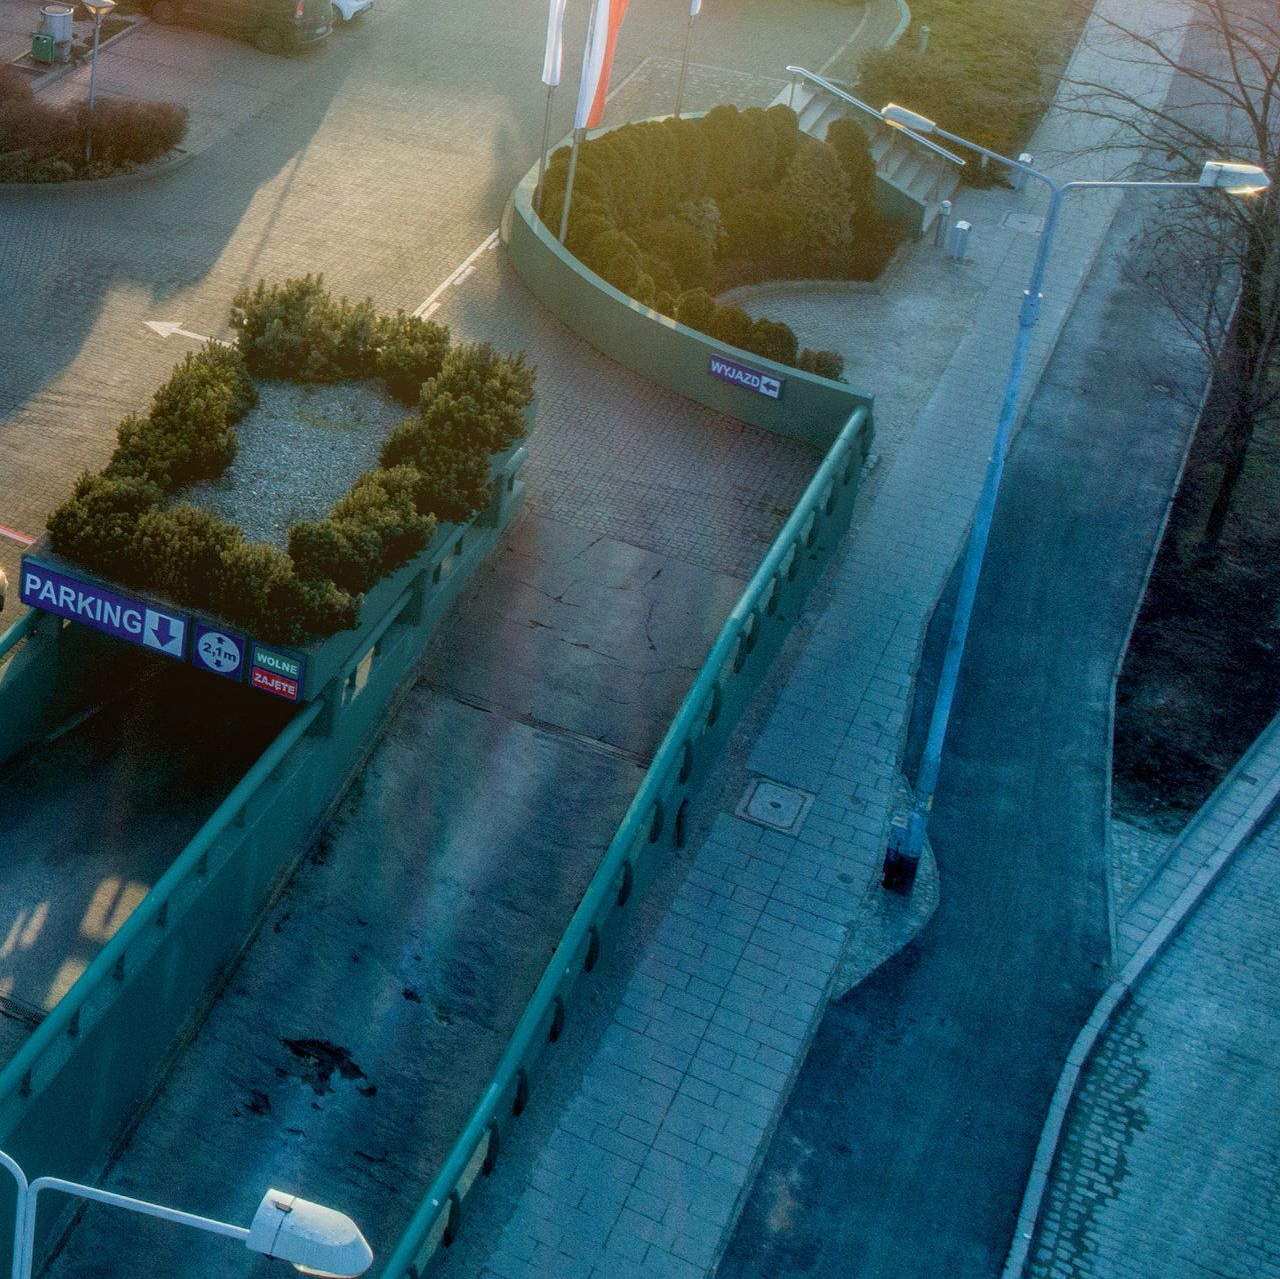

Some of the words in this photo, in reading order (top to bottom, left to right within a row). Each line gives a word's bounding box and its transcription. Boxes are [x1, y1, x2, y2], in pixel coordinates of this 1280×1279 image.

[710, 360, 760, 388] WYJAZD
[24, 572, 142, 634] PARKING
[257, 652, 298, 676] WOLNE
